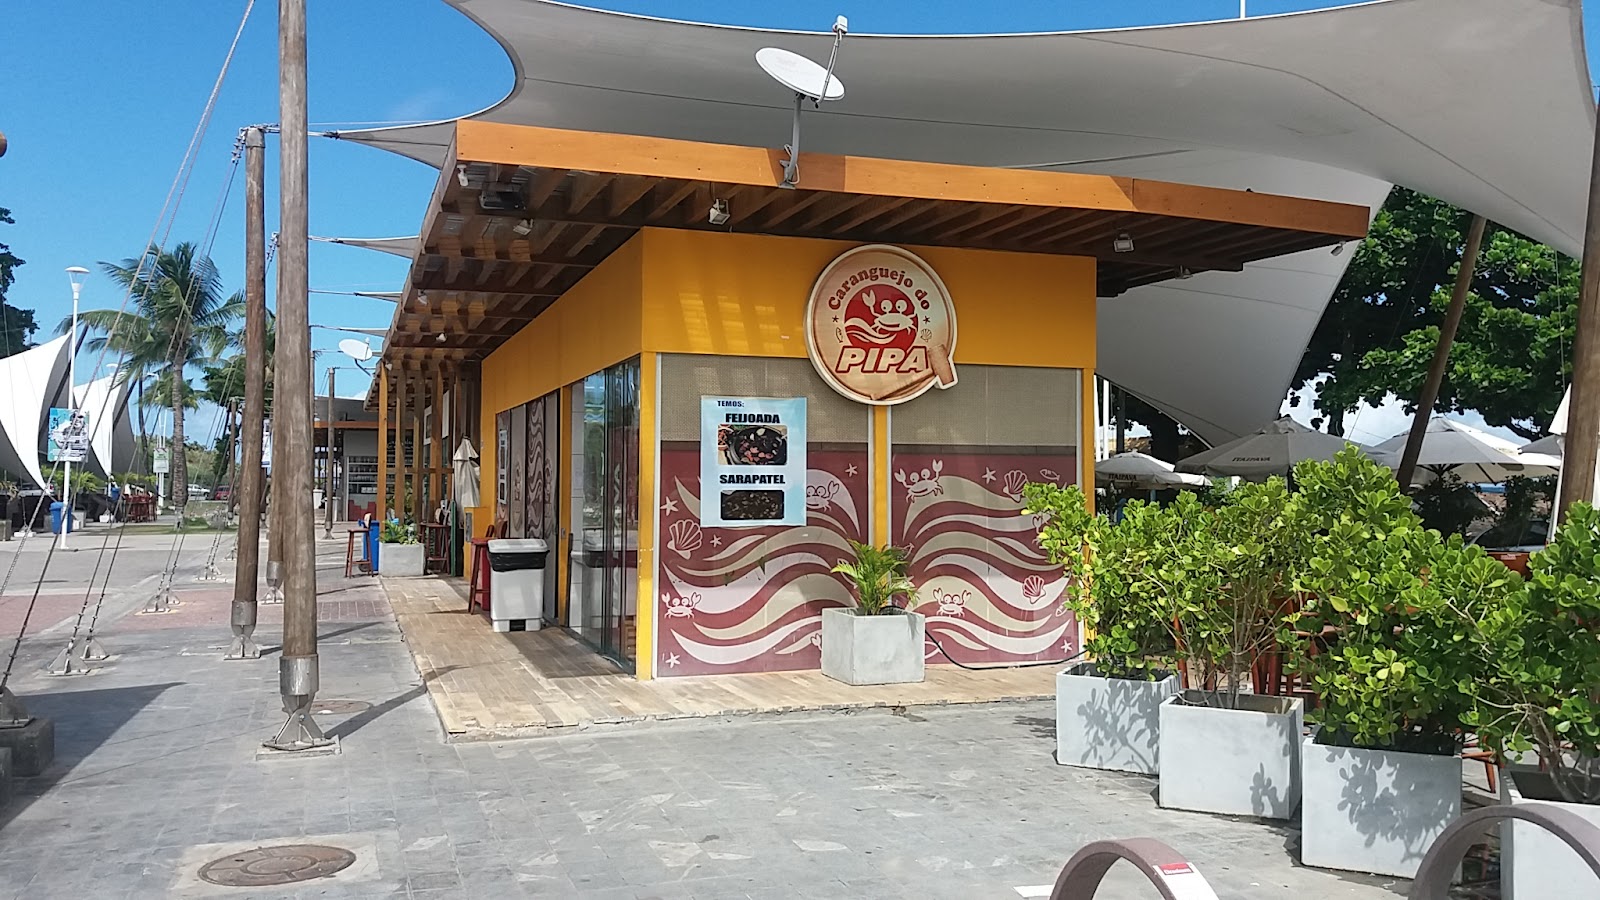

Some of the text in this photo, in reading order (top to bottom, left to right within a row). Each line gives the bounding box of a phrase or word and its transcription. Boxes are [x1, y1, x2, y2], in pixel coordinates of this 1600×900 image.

[828, 267, 930, 310] Caranguejo do
[835, 345, 930, 373] PIPA
[717, 400, 745, 408] TEMOS:
[725, 413, 780, 424] FEIJOADA
[719, 474, 786, 484] SARAPATEL
[1108, 473, 1137, 481] ITAIPAVA
